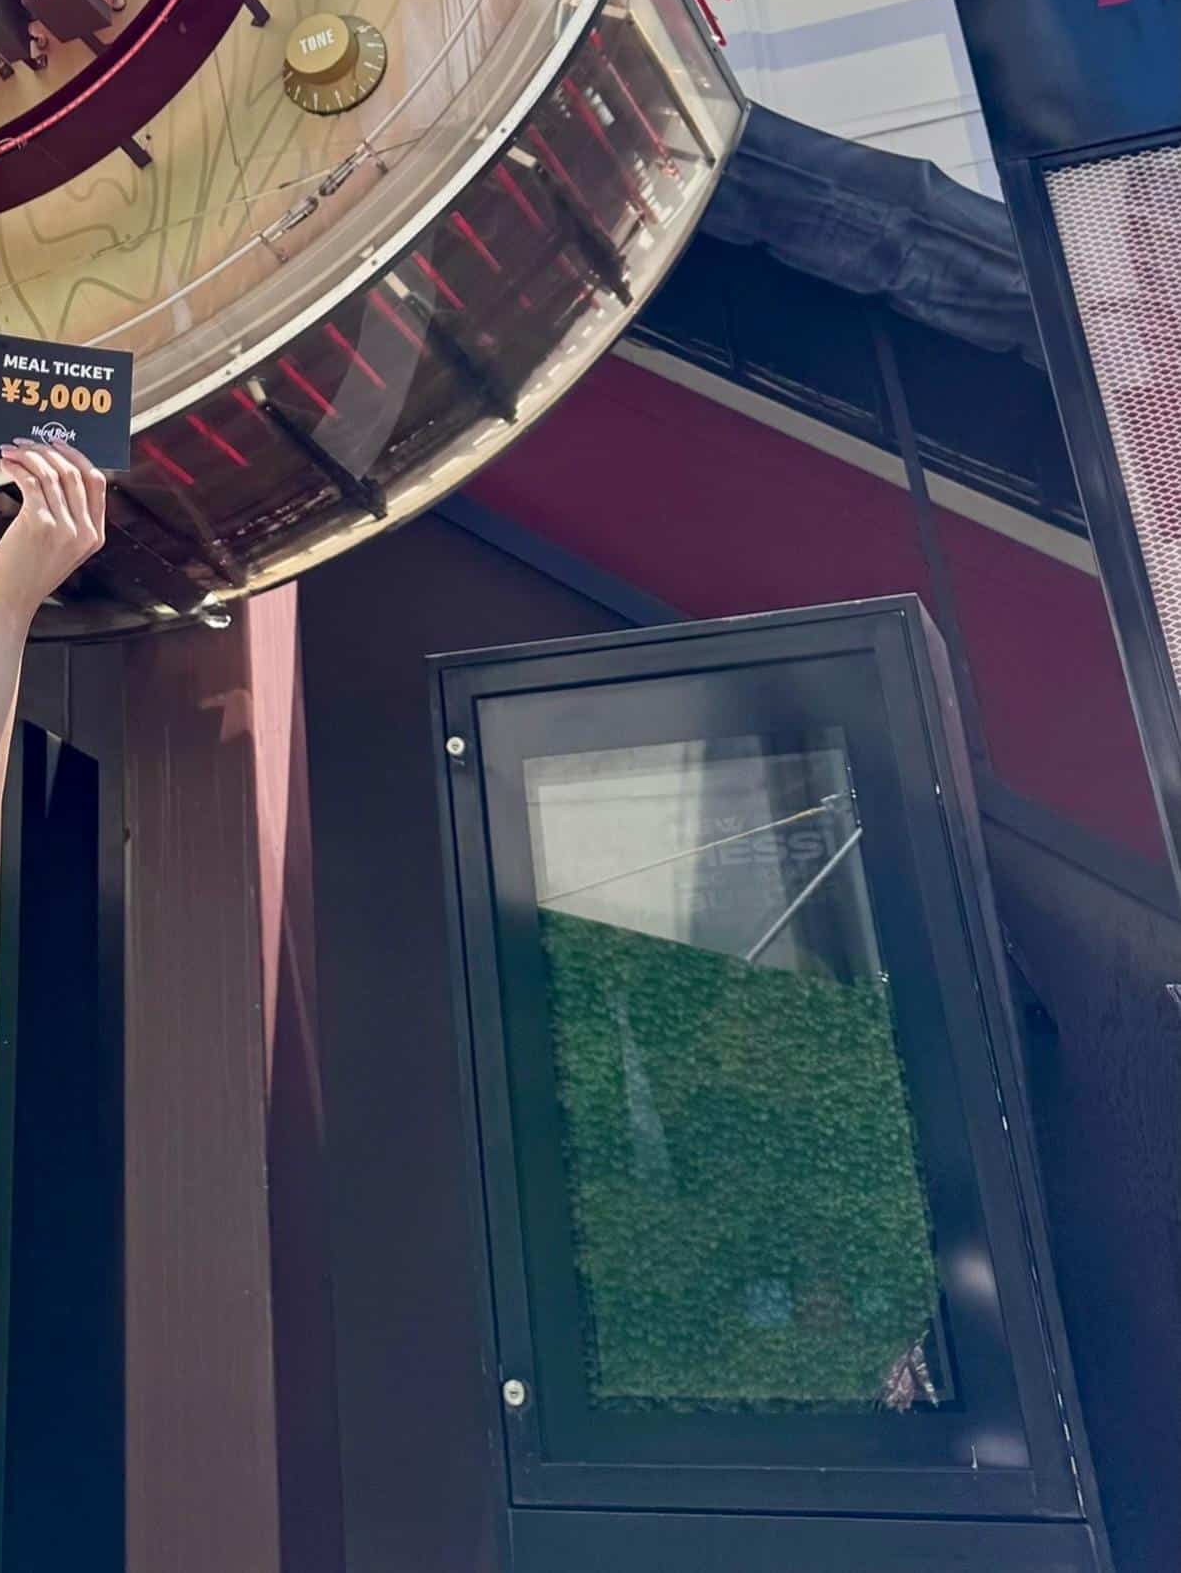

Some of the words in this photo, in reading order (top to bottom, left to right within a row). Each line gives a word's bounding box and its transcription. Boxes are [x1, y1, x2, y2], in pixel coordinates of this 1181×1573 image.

[299, 28, 335, 56] TONE
[3, 354, 50, 374] MEAL
[52, 361, 115, 381] TICKET
[1, 376, 112, 414] ¥3,000
